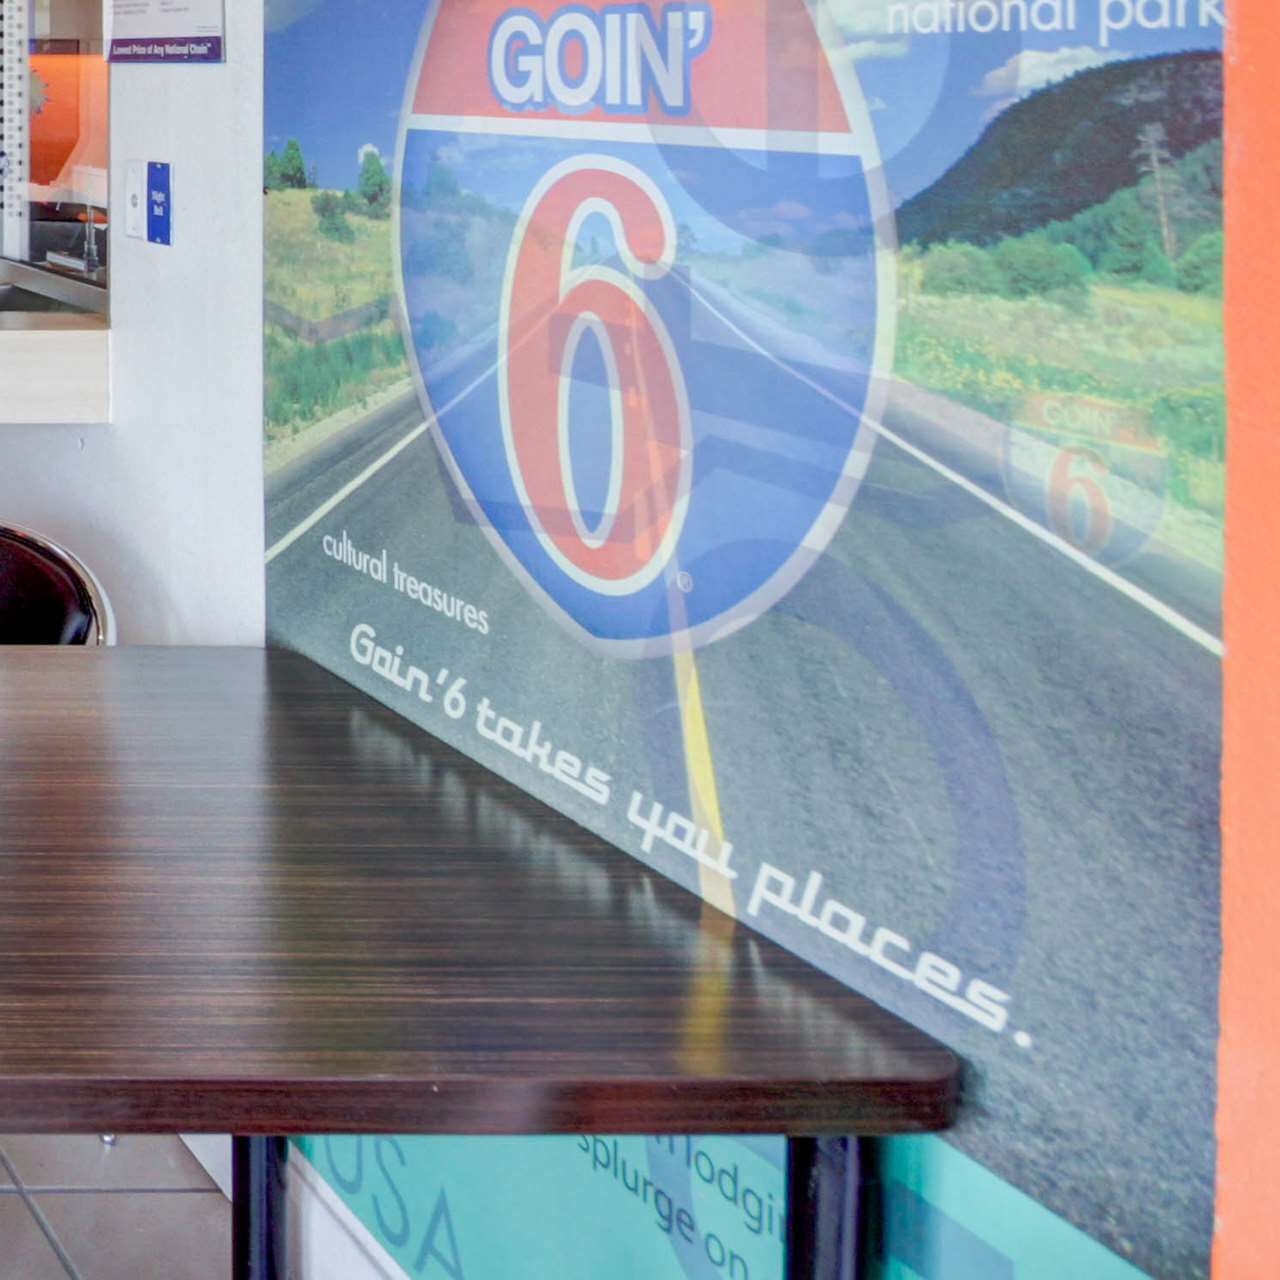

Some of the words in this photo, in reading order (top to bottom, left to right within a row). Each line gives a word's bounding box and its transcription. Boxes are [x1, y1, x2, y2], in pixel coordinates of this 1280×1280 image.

[490, 10, 705, 108] GOIN'
[499, 154, 692, 595] 6
[1048, 447, 1117, 558] 6
[323, 529, 387, 583] cultural
[393, 562, 489, 634] treasures
[476, 697, 613, 806] takes
[627, 792, 738, 879] you
[746, 861, 1032, 1049] places.
[686, 1135, 786, 1235] lodgi
